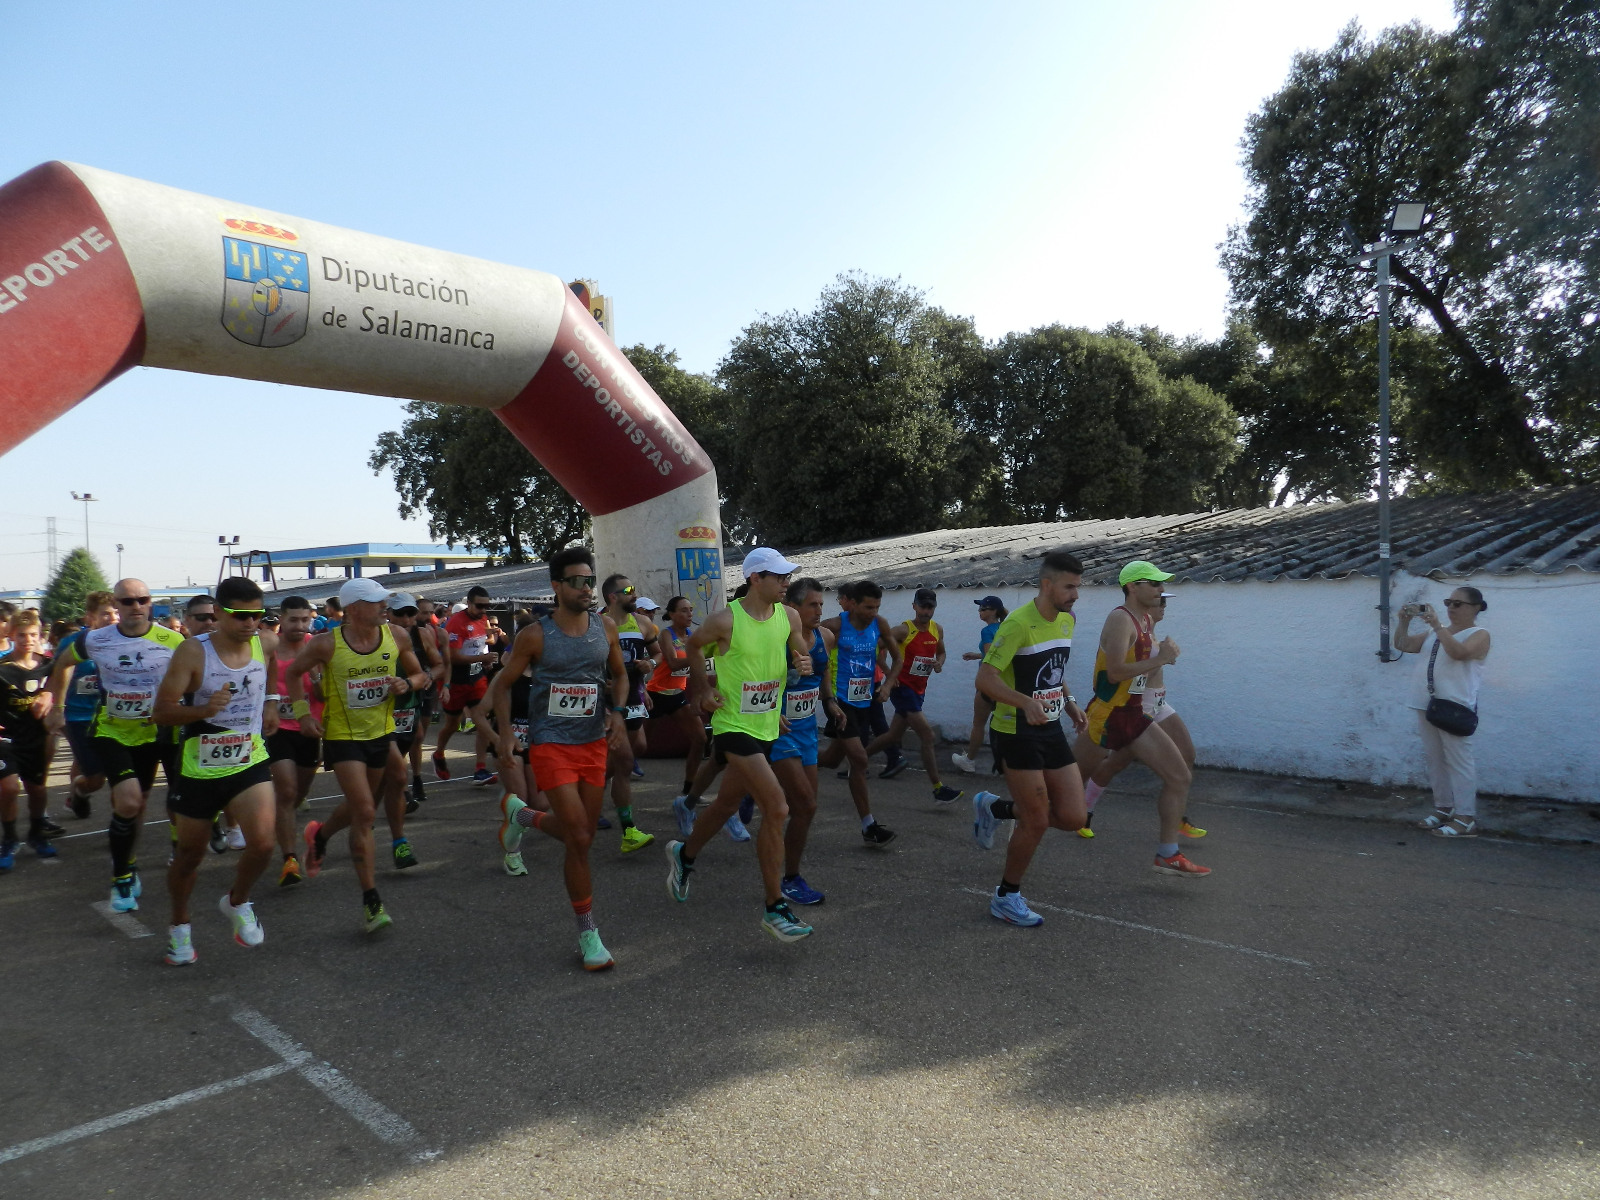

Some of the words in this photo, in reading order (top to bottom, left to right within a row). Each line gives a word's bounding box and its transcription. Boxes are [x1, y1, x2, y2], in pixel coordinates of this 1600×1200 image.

[322, 256, 469, 306] Diputación
[322, 306, 347, 328] de
[359, 306, 495, 350] Salamanca
[574, 325, 611, 369] CON
[611, 367, 694, 465] NUESTROS
[562, 349, 673, 475] DEPORTISTAS
[743, 681, 780, 692] bedunia
[1137, 676, 1147, 687] 67
[108, 691, 152, 701] bedunia
[358, 687, 383, 700] 603
[552, 685, 597, 696] bedunia
[788, 690, 819, 700] bedunia
[559, 695, 587, 709] 671
[751, 691, 773, 705] 644
[116, 701, 143, 711] 672
[280, 704, 293, 713] 67
[795, 699, 814, 712] 601
[201, 733, 251, 745] bedunia
[211, 744, 243, 759] 687
